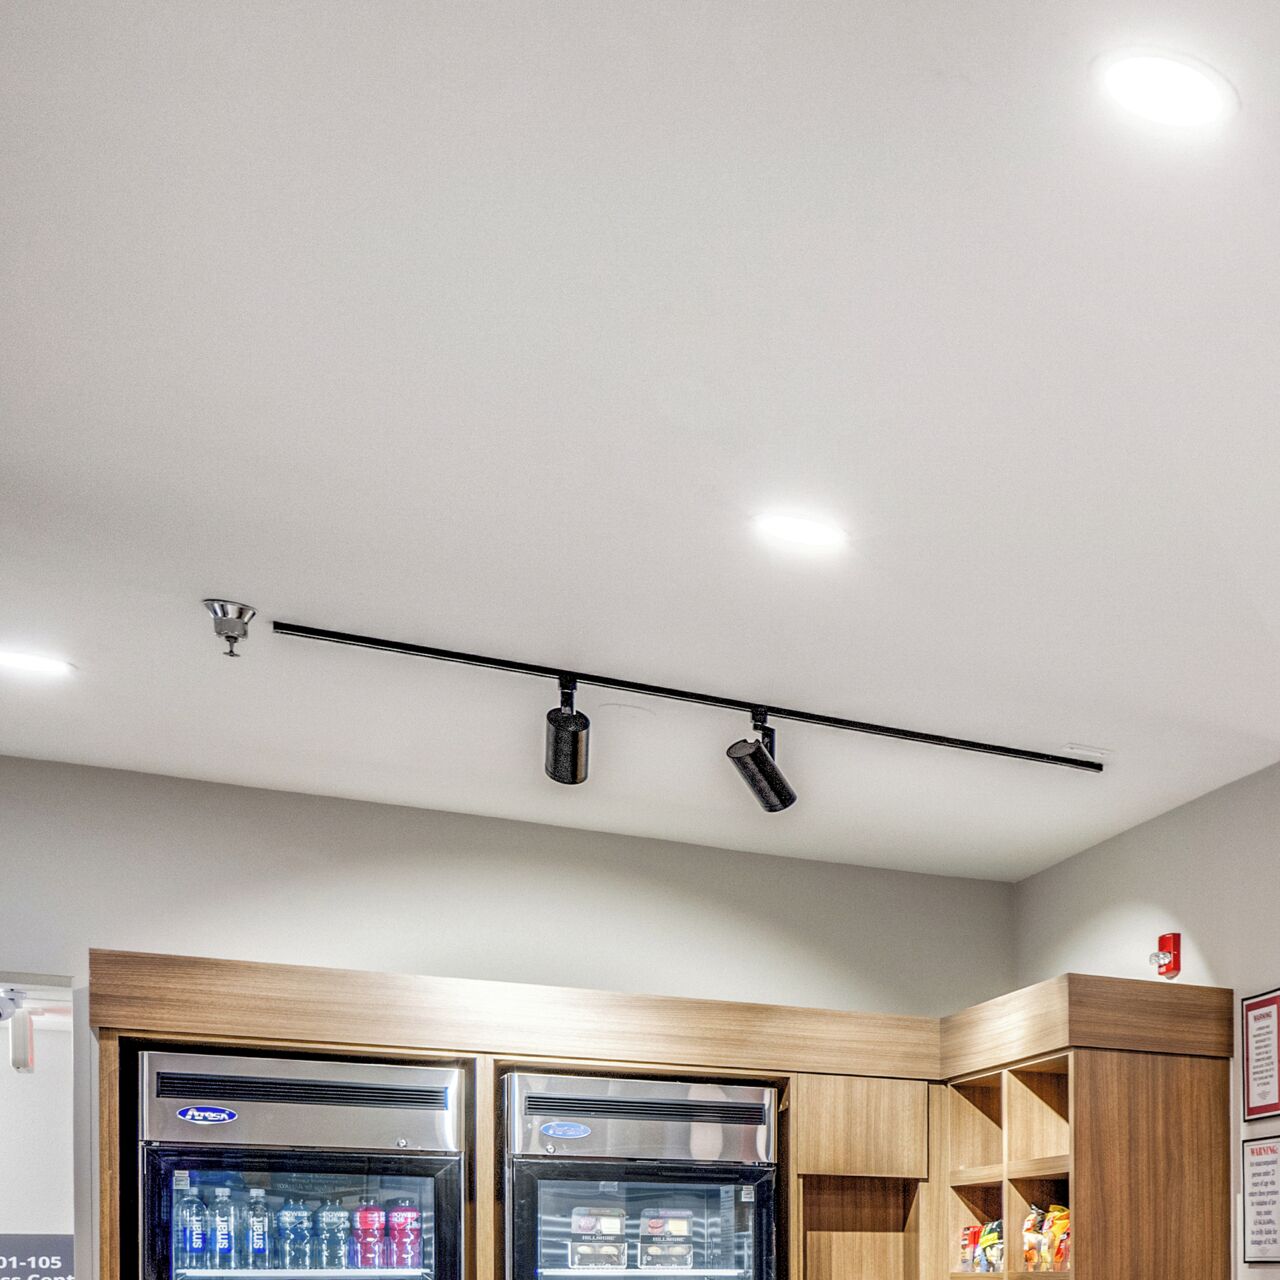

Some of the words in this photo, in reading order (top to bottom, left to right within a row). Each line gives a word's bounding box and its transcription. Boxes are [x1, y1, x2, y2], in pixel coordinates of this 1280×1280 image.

[192, 1216, 203, 1248] smart
[217, 1216, 229, 1248] smart
[252, 1217, 264, 1249] smart
